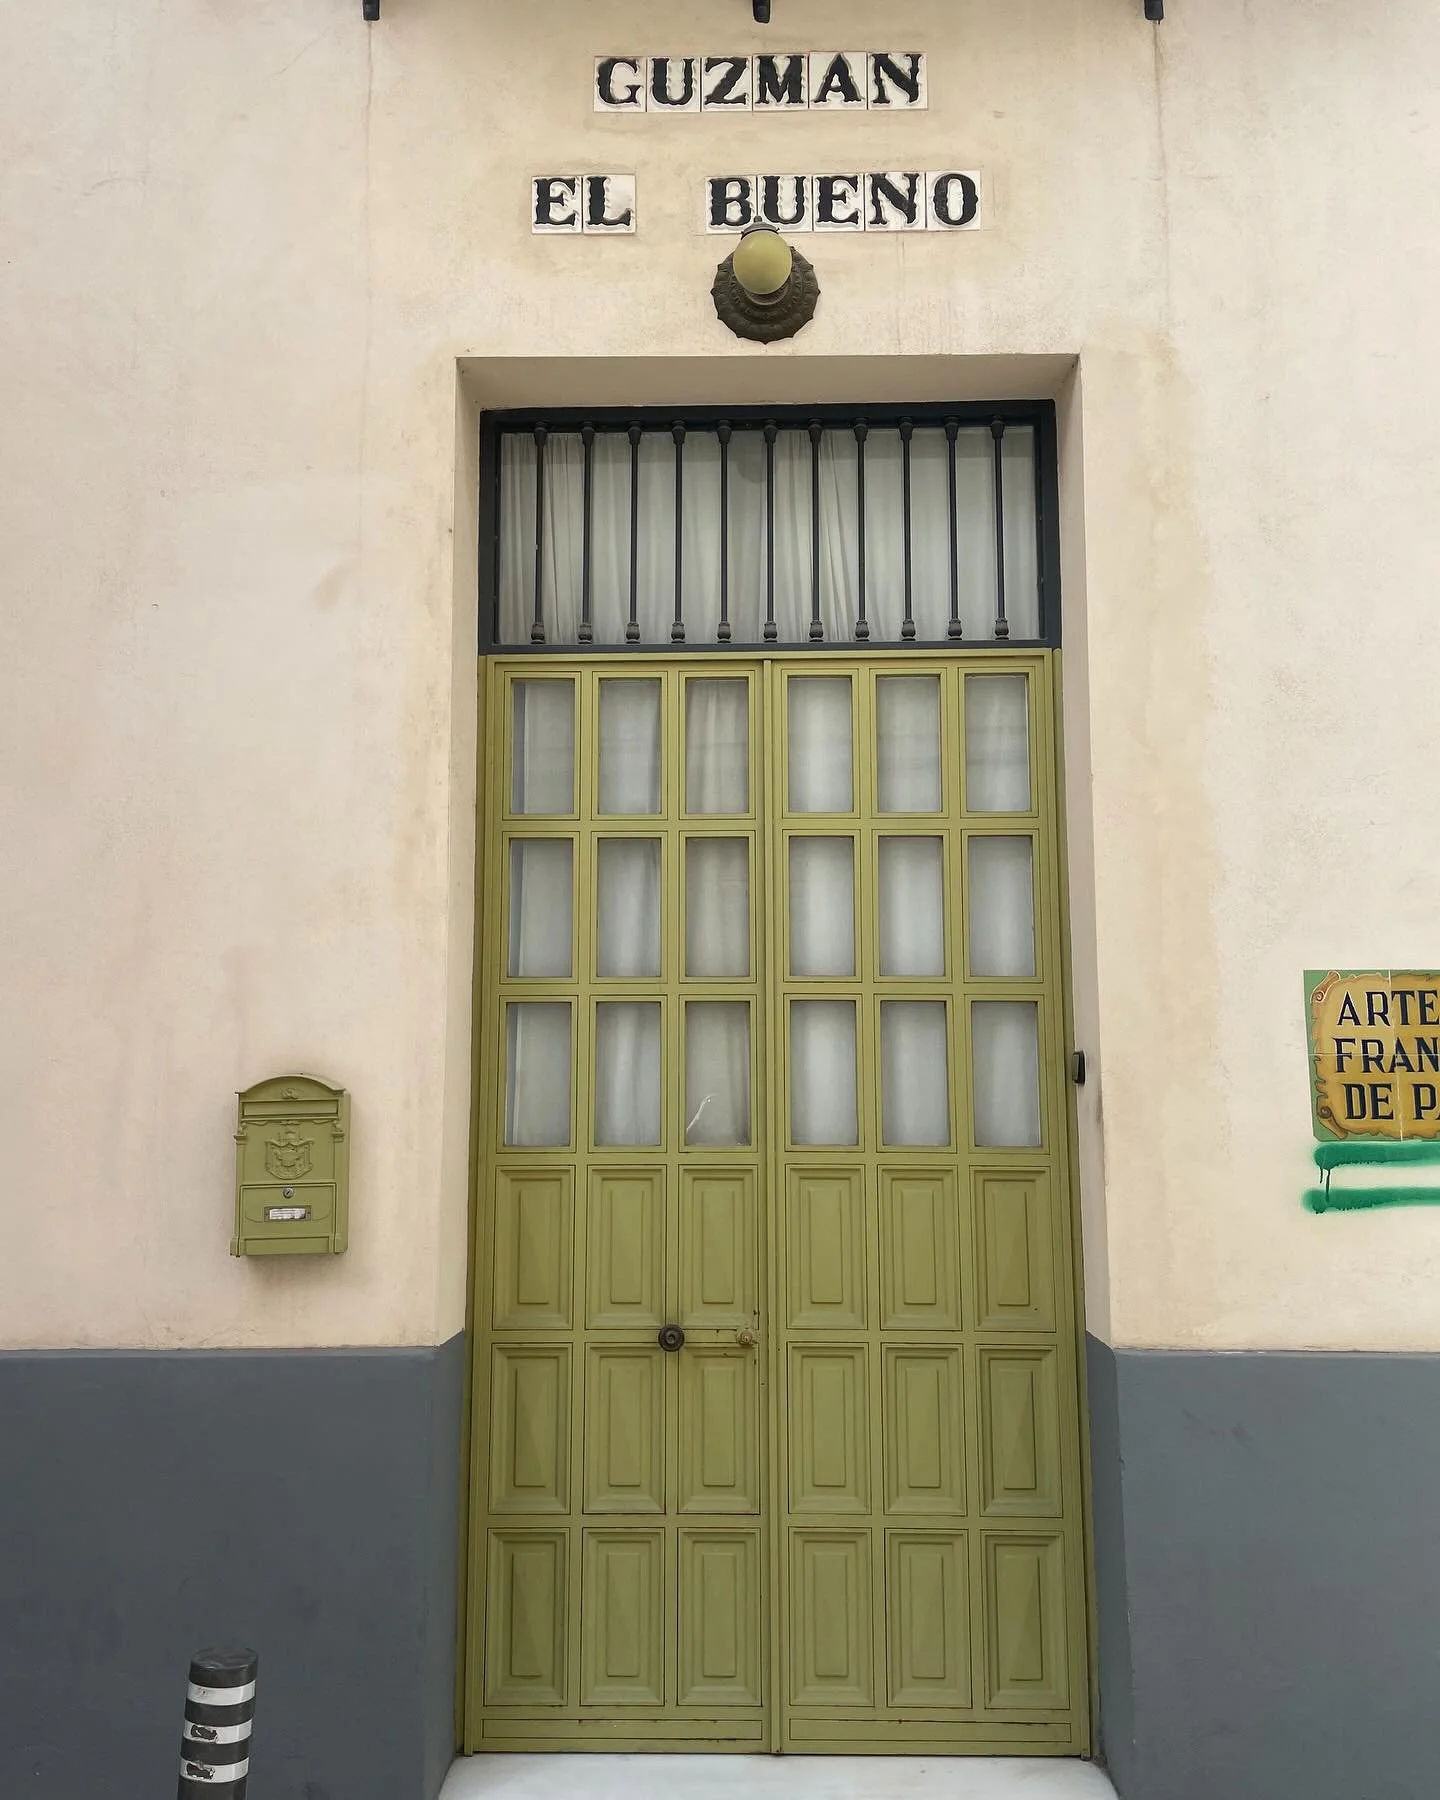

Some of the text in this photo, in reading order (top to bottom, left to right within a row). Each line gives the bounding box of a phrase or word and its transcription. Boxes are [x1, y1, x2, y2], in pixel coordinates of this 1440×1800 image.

[597, 52, 921, 106] GUZMAN
[534, 172, 979, 227] EL BUENO
[1343, 1083, 1440, 1120] DE P
